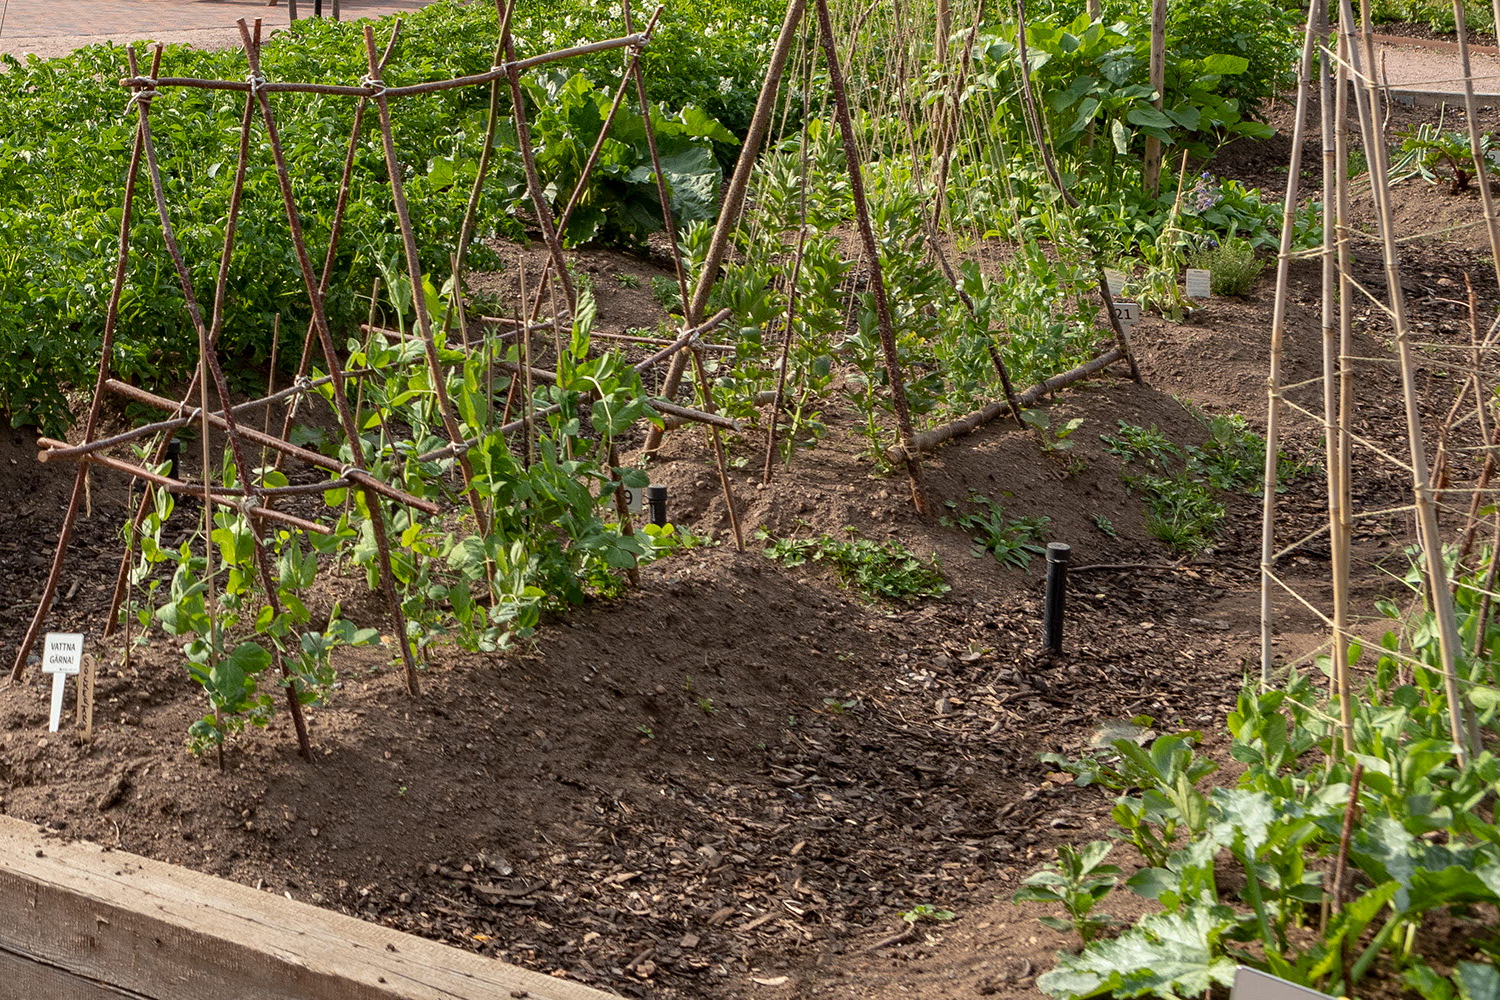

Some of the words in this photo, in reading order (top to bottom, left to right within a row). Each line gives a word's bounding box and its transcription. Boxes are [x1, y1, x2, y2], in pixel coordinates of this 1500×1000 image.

[1115, 308, 1132, 320] 21
[50, 642, 76, 652] VATTNA
[49, 654, 75, 665] GÄRNA!
